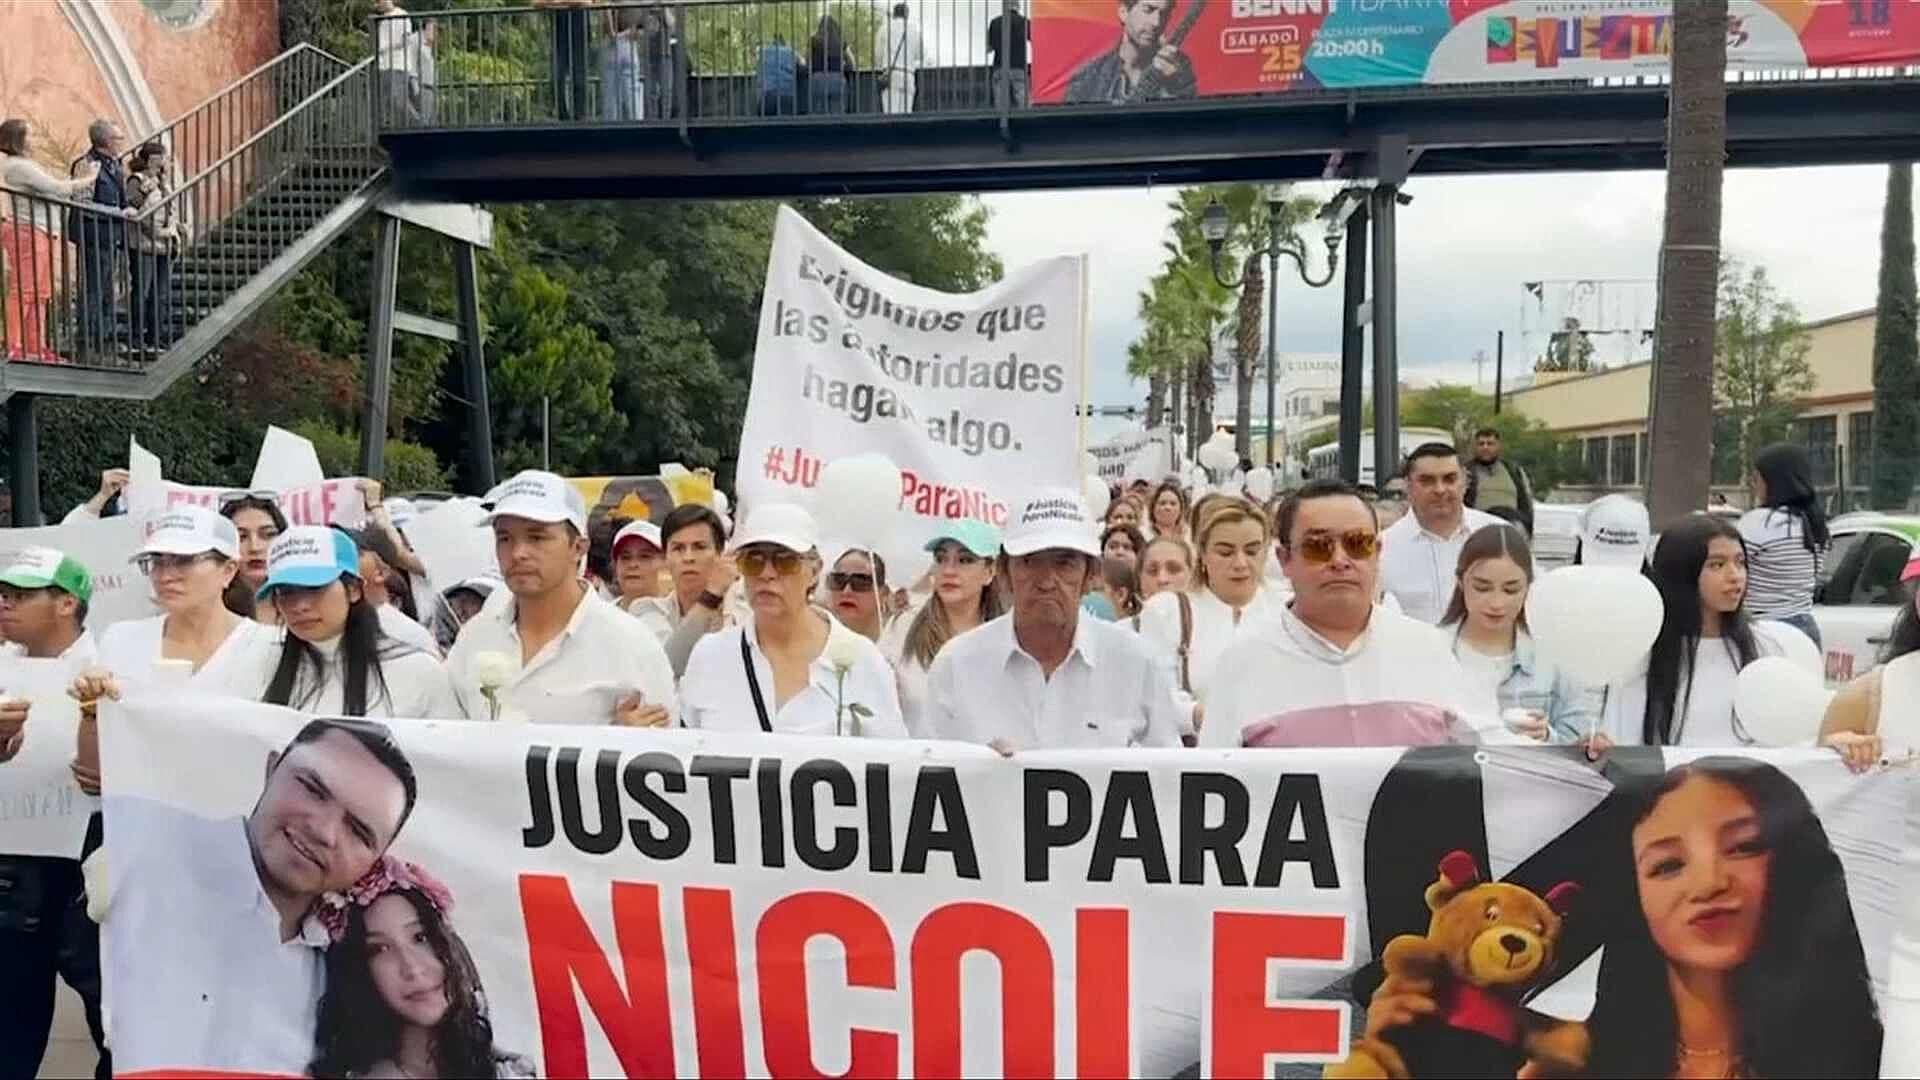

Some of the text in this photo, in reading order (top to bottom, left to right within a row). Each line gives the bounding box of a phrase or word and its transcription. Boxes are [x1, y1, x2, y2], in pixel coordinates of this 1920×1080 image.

[1261, 45, 1302, 72] 25
[773, 300, 830, 344] las
[976, 302, 1047, 342] que
[928, 410, 1023, 456] algo.
[522, 745, 1341, 889] JUSTICIA PARA
[517, 873, 1349, 1080] NICOLE
